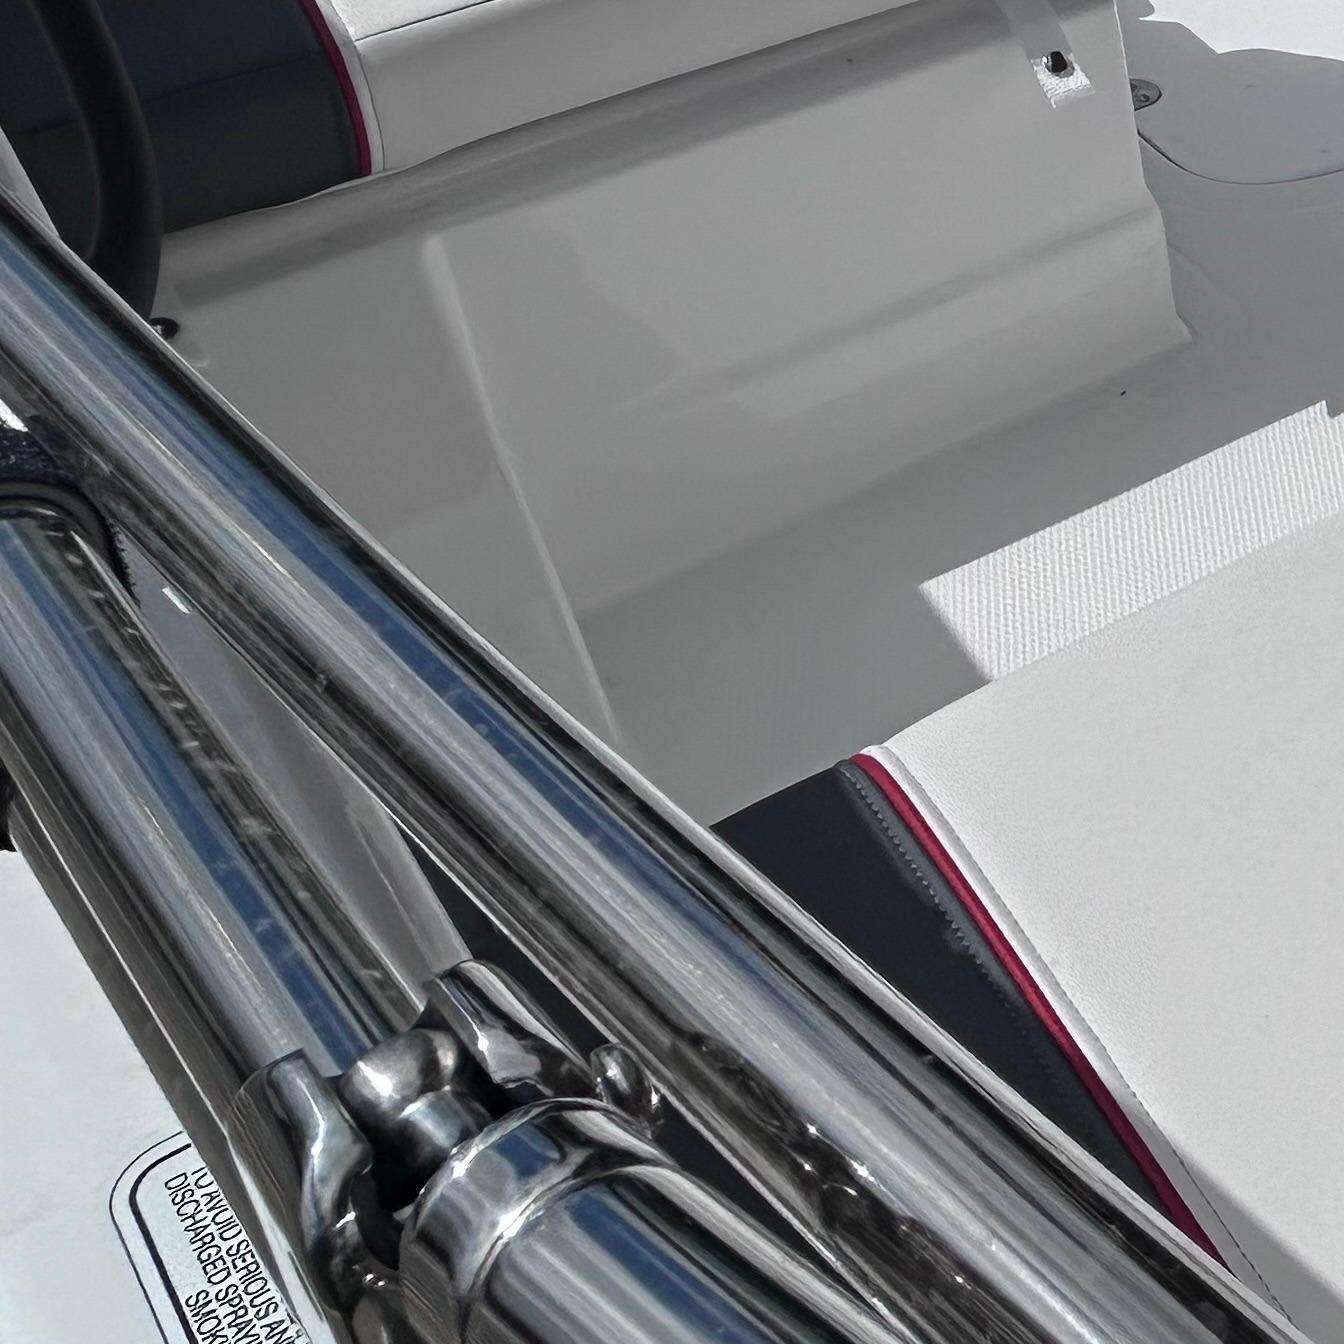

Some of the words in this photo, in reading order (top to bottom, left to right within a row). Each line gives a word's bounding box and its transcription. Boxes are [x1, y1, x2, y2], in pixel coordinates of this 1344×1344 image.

[164, 1172, 232, 1285] DISCHARGED
[200, 1190, 242, 1241] AVOID
[226, 1239, 279, 1320] SERIOUS
